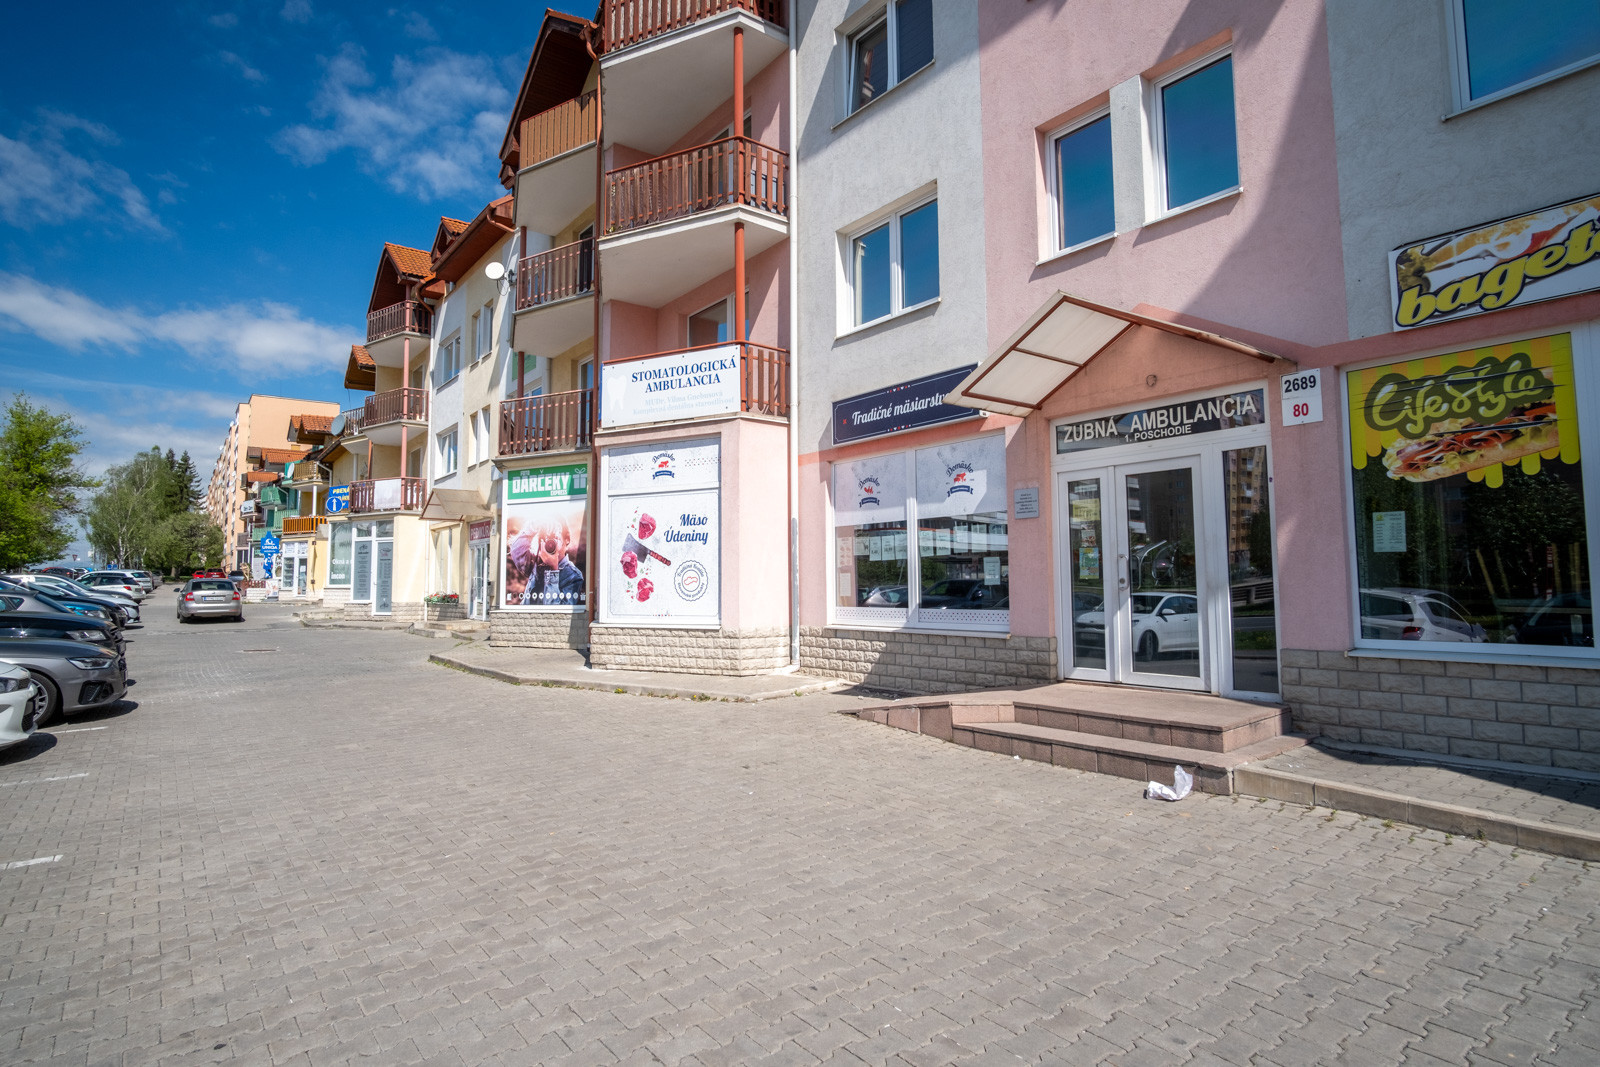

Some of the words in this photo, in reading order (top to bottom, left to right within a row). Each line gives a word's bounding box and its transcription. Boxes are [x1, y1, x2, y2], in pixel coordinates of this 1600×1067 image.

[1396, 218, 1600, 327] baget
[631, 355, 737, 383] STOMATOLOGICKÁ
[645, 373, 721, 393] AMBULANCIA
[1284, 375, 1317, 393] 2689
[852, 403, 892, 425] Tradičné
[893, 393, 950, 416] mäsiarstv
[1063, 416, 1118, 443] ZUBNÁ
[1130, 394, 1257, 433] AMBULANCIA
[1293, 403, 1309, 417] 80
[1125, 434, 1132, 443] 1.
[1134, 424, 1192, 441] POSCHODIE
[512, 469, 570, 494] DARČEKY
[680, 513, 708, 527] Mäso
[663, 526, 709, 546] Údeniny
